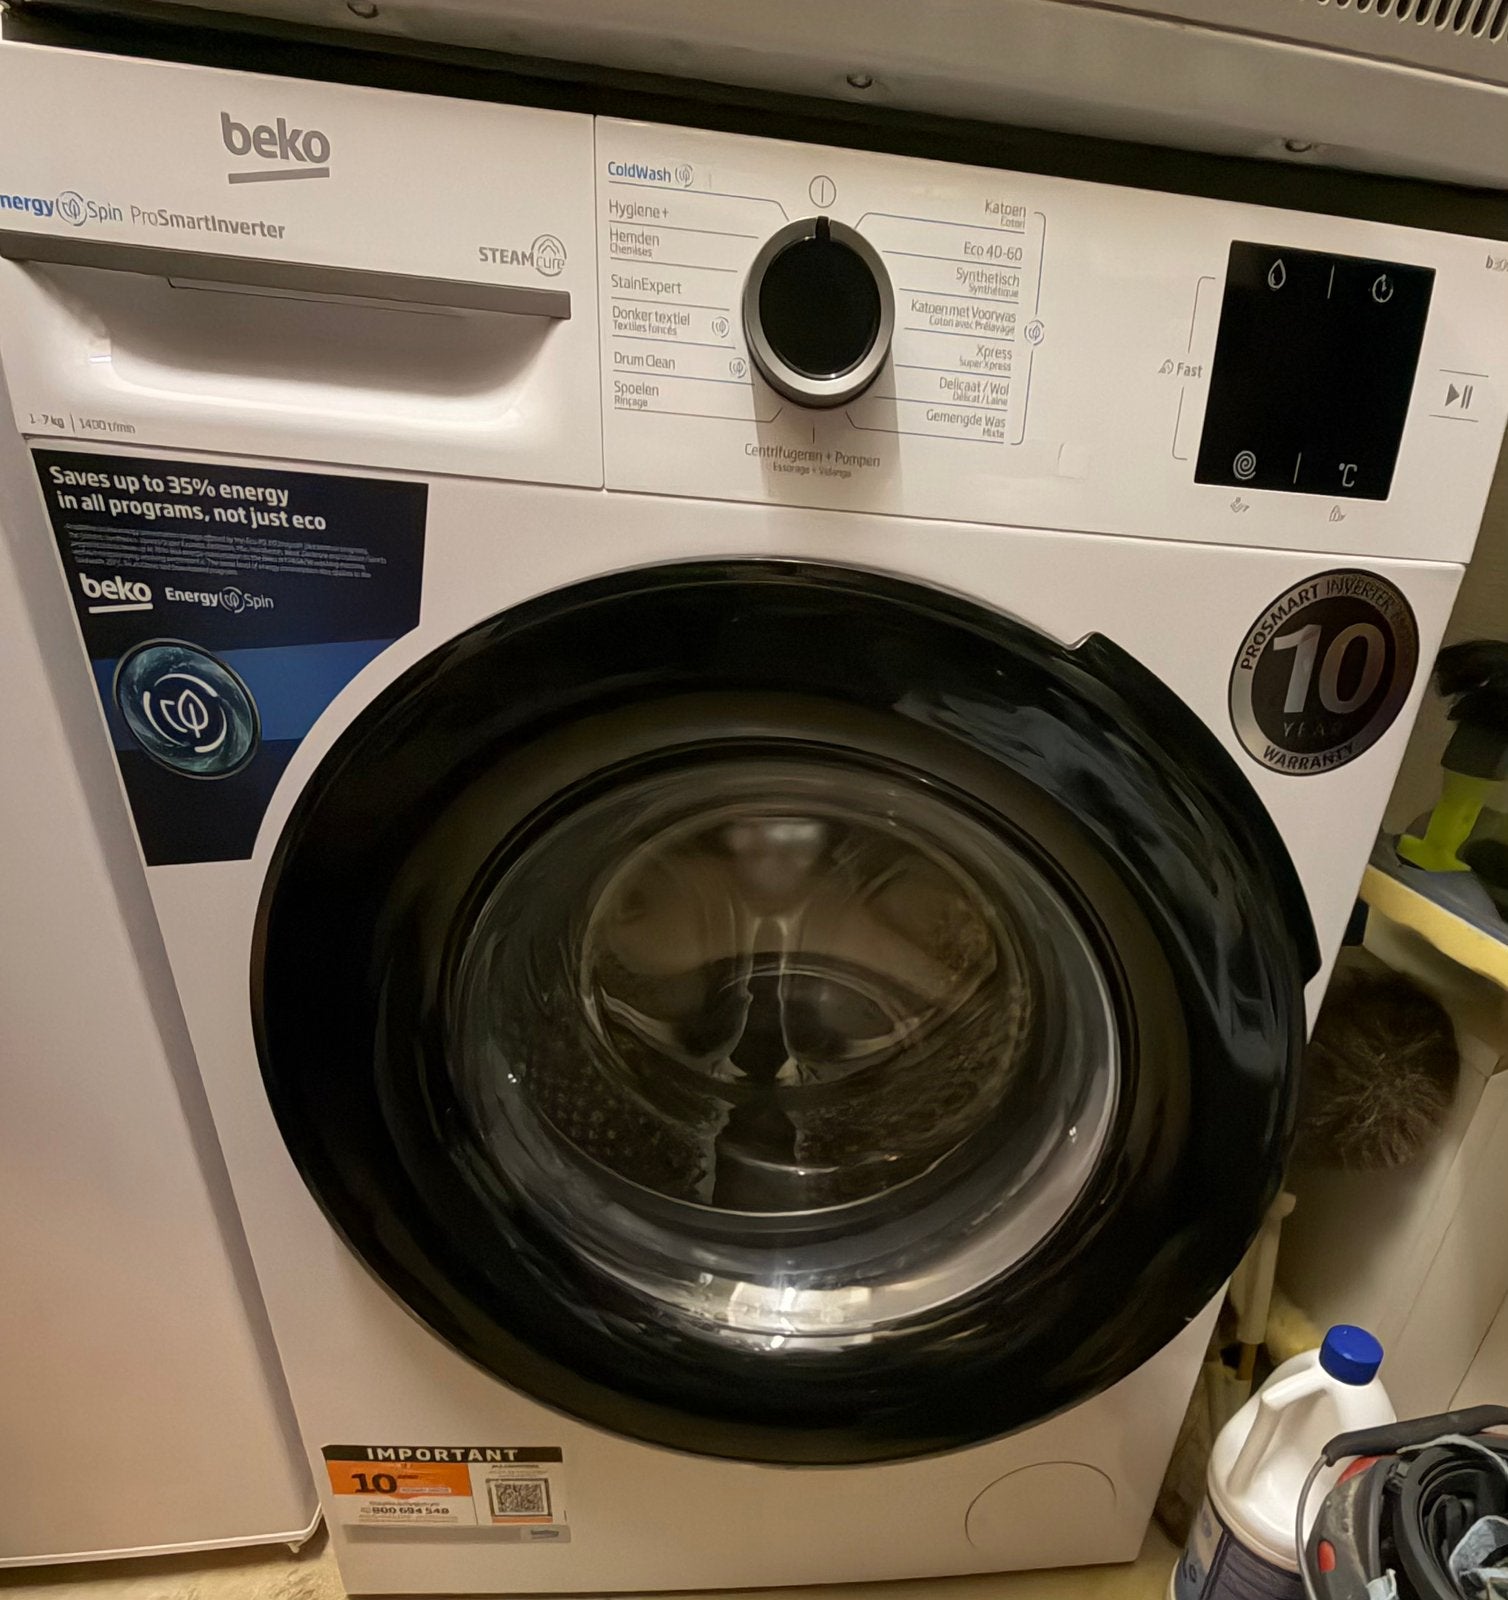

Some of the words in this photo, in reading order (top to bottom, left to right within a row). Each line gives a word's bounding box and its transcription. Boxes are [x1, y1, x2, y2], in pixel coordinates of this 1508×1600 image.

[220, 111, 331, 164] beko
[607, 160, 672, 183] ColdWash
[0, 194, 55, 217] nergy
[86, 200, 123, 224] Spin
[130, 204, 286, 240] ProSmartInverter
[984, 199, 1027, 218] Katoen
[609, 225, 660, 248] Hemden
[963, 240, 984, 257] Eco
[986, 244, 1023, 261] 40-60
[610, 273, 683, 296] StainExpert
[955, 266, 1021, 288] Synthetisch
[612, 304, 653, 322] Donker
[654, 309, 691, 327] textiel
[910, 298, 950, 315] Katoen
[971, 306, 1018, 325] Voorwas
[613, 319, 648, 333] Textiles
[613, 350, 645, 367] Drum
[645, 354, 677, 371] Clean
[975, 343, 1014, 361] Xpress
[1176, 361, 1204, 379] Fast
[613, 380, 661, 397] Spoelen
[938, 376, 982, 393] Delicaat
[990, 382, 1010, 396] Wol
[926, 408, 983, 428] Gemengde
[983, 415, 1007, 429] Was
[834, 451, 880, 468] Pompen
[48, 465, 111, 488] Saves
[113, 474, 140, 494] up
[142, 474, 165, 493] to
[166, 475, 216, 497] 35%
[219, 483, 289, 508] energy
[56, 490, 79, 509] in
[80, 493, 106, 512] all
[108, 499, 210, 522] programs,
[212, 506, 249, 525] not
[248, 506, 290, 529] just
[291, 514, 327, 531] eco
[78, 572, 152, 602] beko
[164, 586, 219, 608] Energy
[243, 593, 275, 609] Spin
[1240, 582, 1320, 671] PROSMART
[1272, 622, 1386, 714] 10
[1263, 744, 1353, 770] WARRANTY
[366, 1447, 519, 1461] IMPORTANT
[351, 1473, 398, 1494] 10
